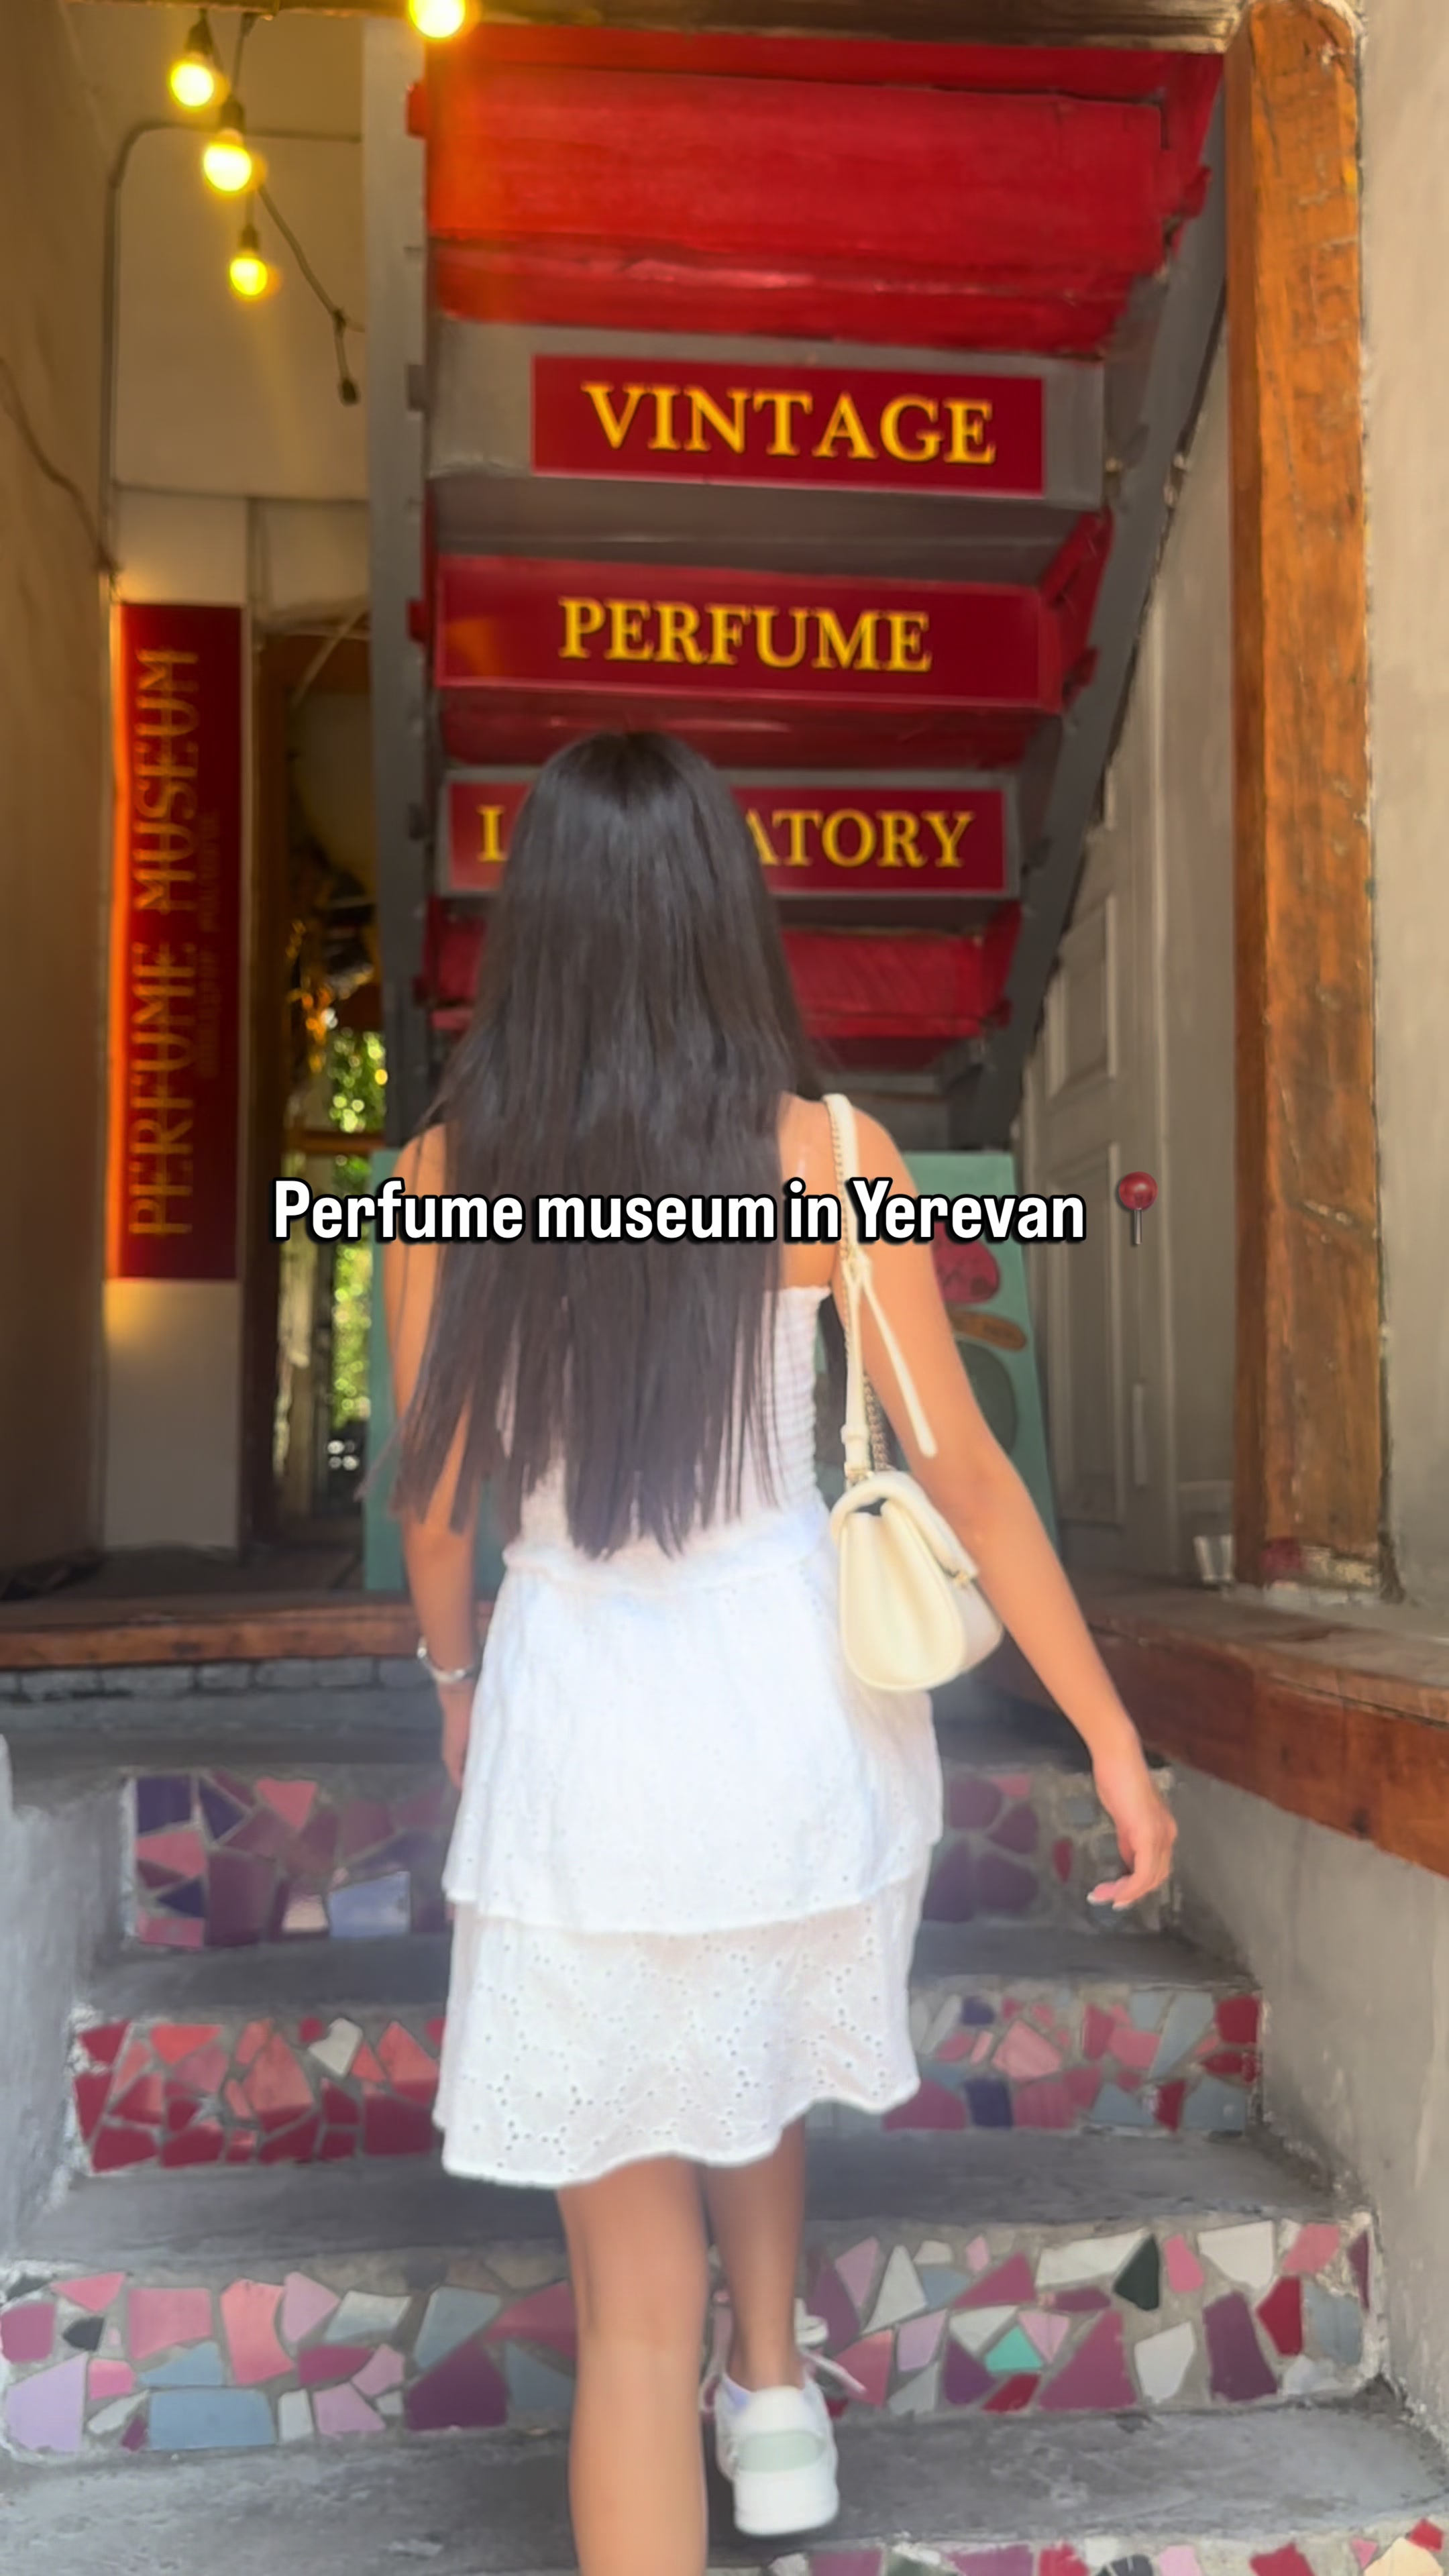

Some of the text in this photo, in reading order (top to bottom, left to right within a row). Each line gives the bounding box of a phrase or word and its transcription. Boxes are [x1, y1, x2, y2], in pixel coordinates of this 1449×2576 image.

[581, 382, 998, 466] VINTAGE
[559, 596, 932, 673] PERFUME
[475, 804, 975, 868] LATORY
[126, 647, 199, 1236] PERFUME MUSEUM
